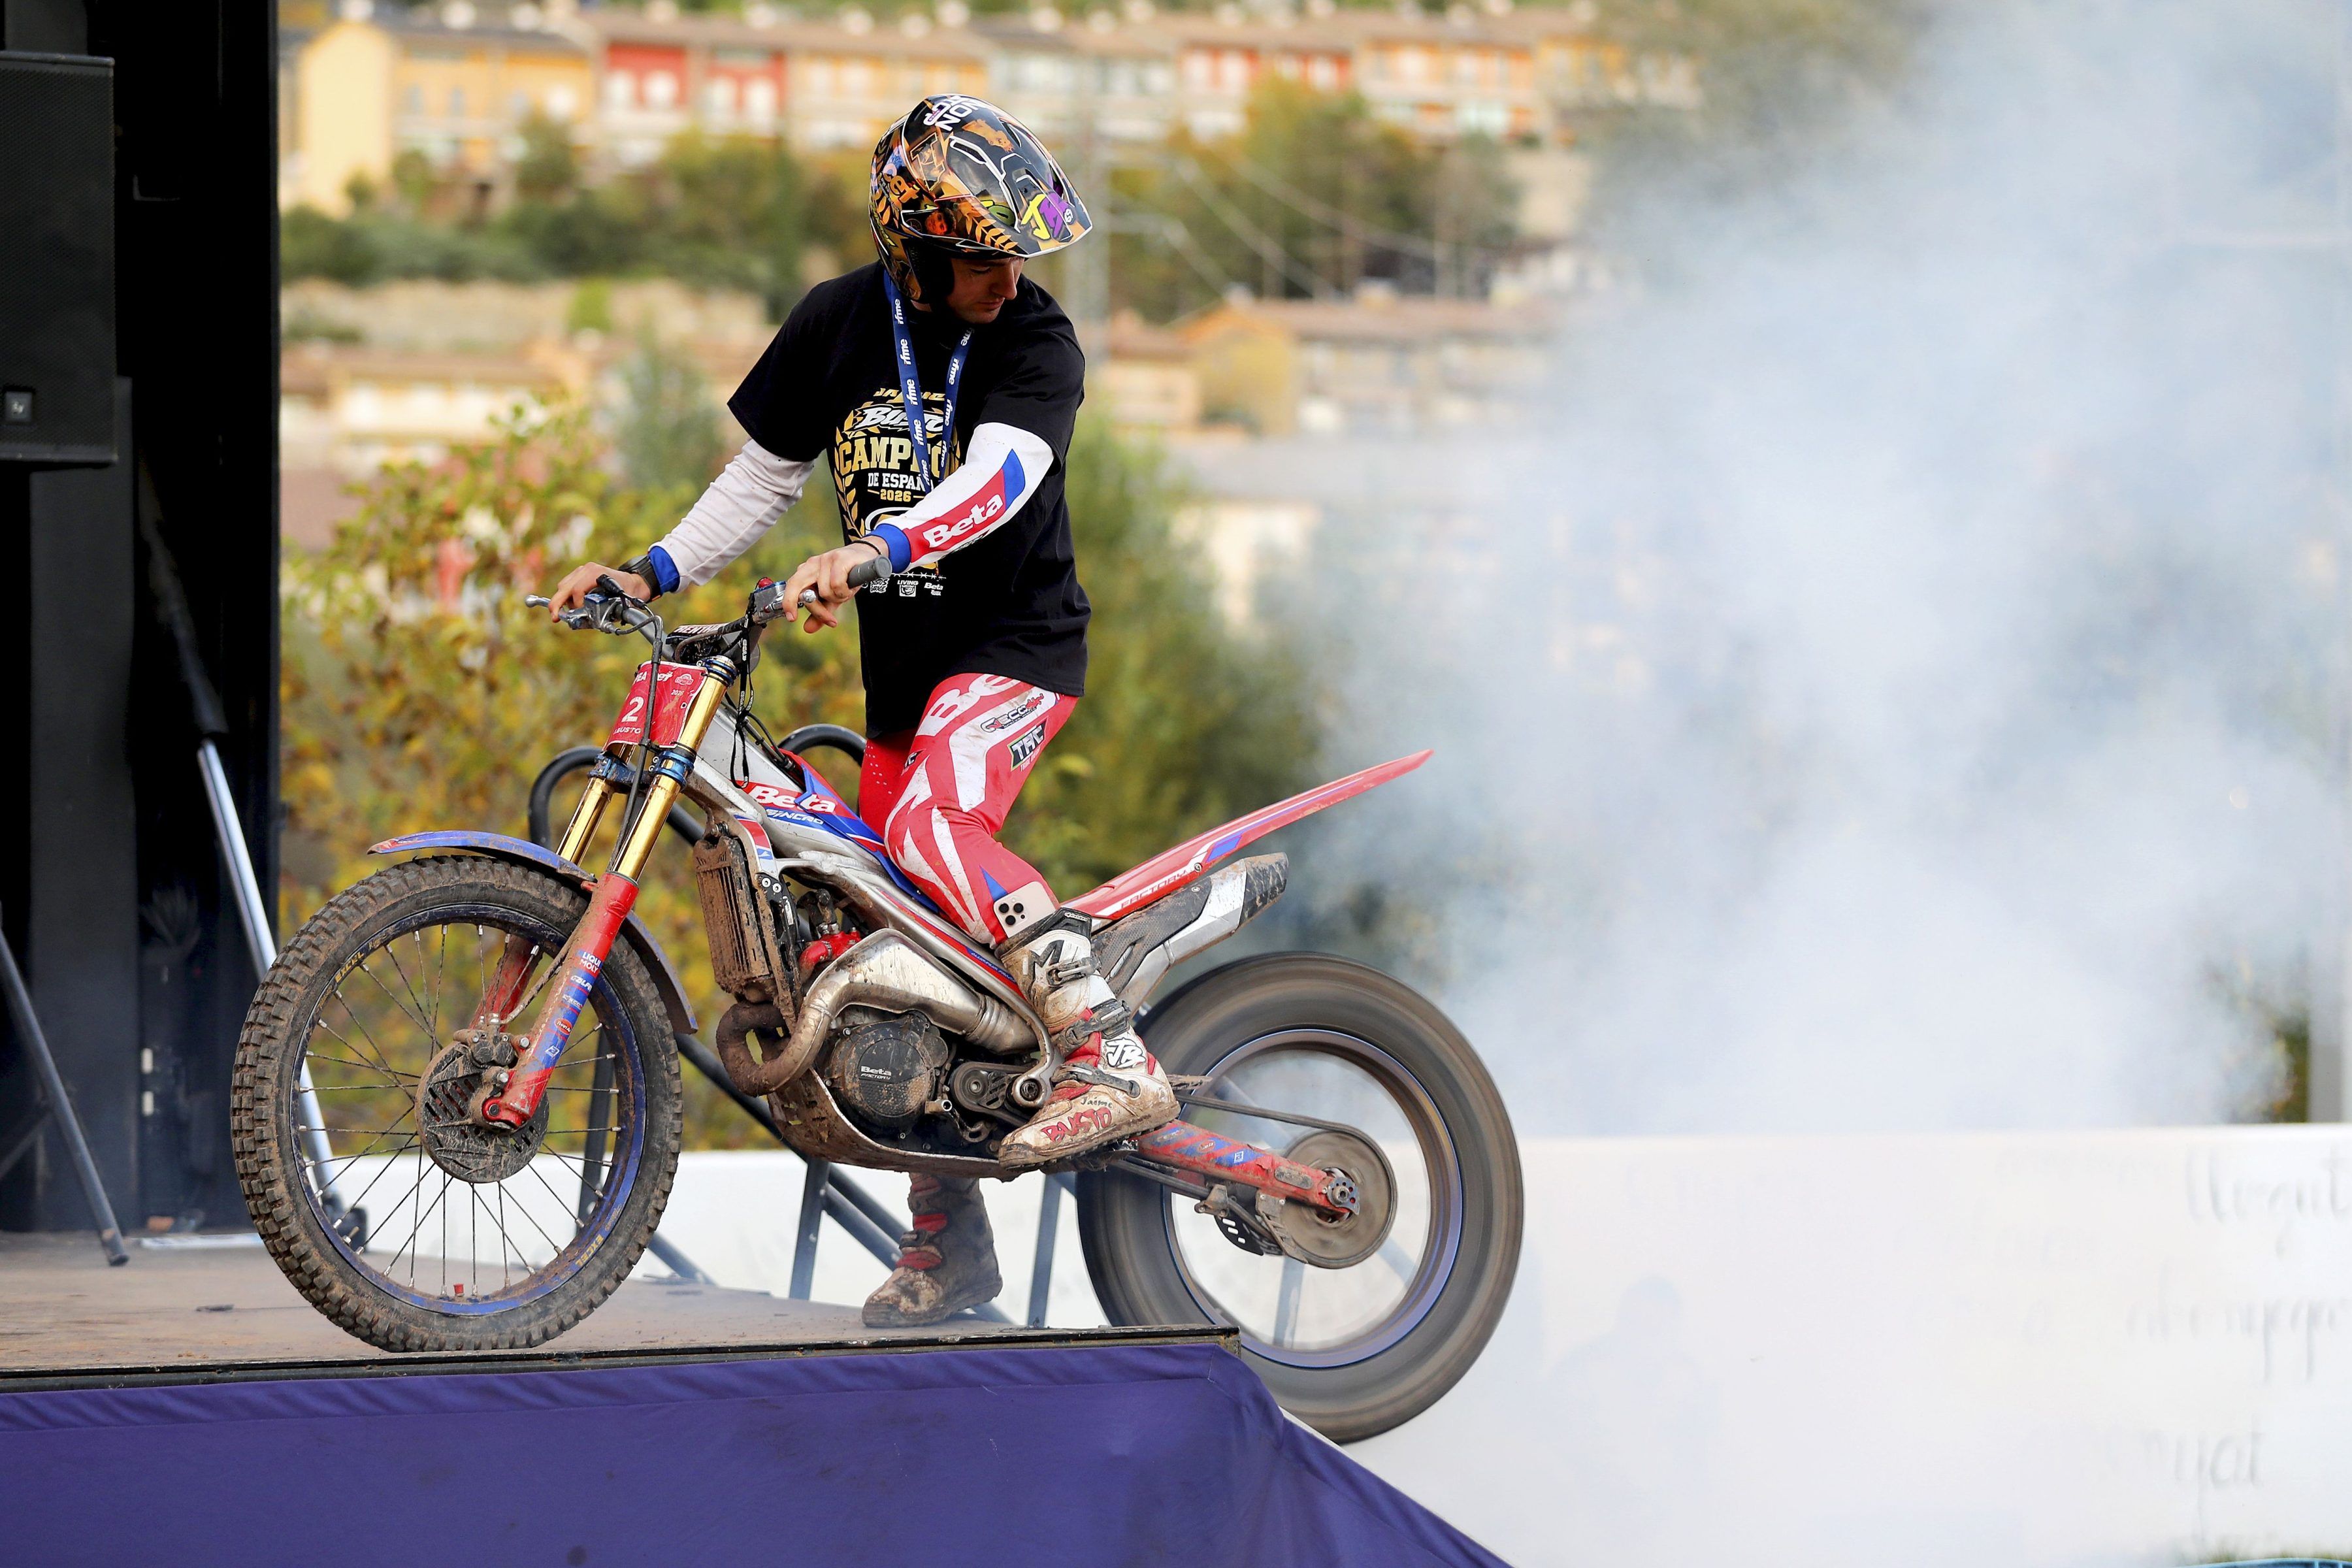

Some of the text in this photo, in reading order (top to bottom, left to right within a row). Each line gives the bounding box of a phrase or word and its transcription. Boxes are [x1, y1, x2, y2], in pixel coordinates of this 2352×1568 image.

[894, 299, 904, 325] rfme
[900, 338, 911, 365] rfme
[949, 358, 960, 385] rfme
[906, 379, 919, 406] rfme
[945, 399, 954, 427] rfme
[913, 419, 924, 446] rfme
[868, 472, 934, 491] DE ESPAÑ
[923, 494, 1004, 548] Beta
[621, 696, 644, 723] 2
[1011, 725, 1045, 760] TAC
[749, 785, 836, 813] Beta
[335, 951, 365, 983] EXCEL
[580, 959, 598, 973] MOLY
[582, 951, 602, 968] LIQUI
[1105, 1037, 1147, 1070] JB
[860, 1066, 892, 1077] Beta
[1041, 1107, 1113, 1143] BUSTO
[575, 1233, 604, 1266] EXCEL
